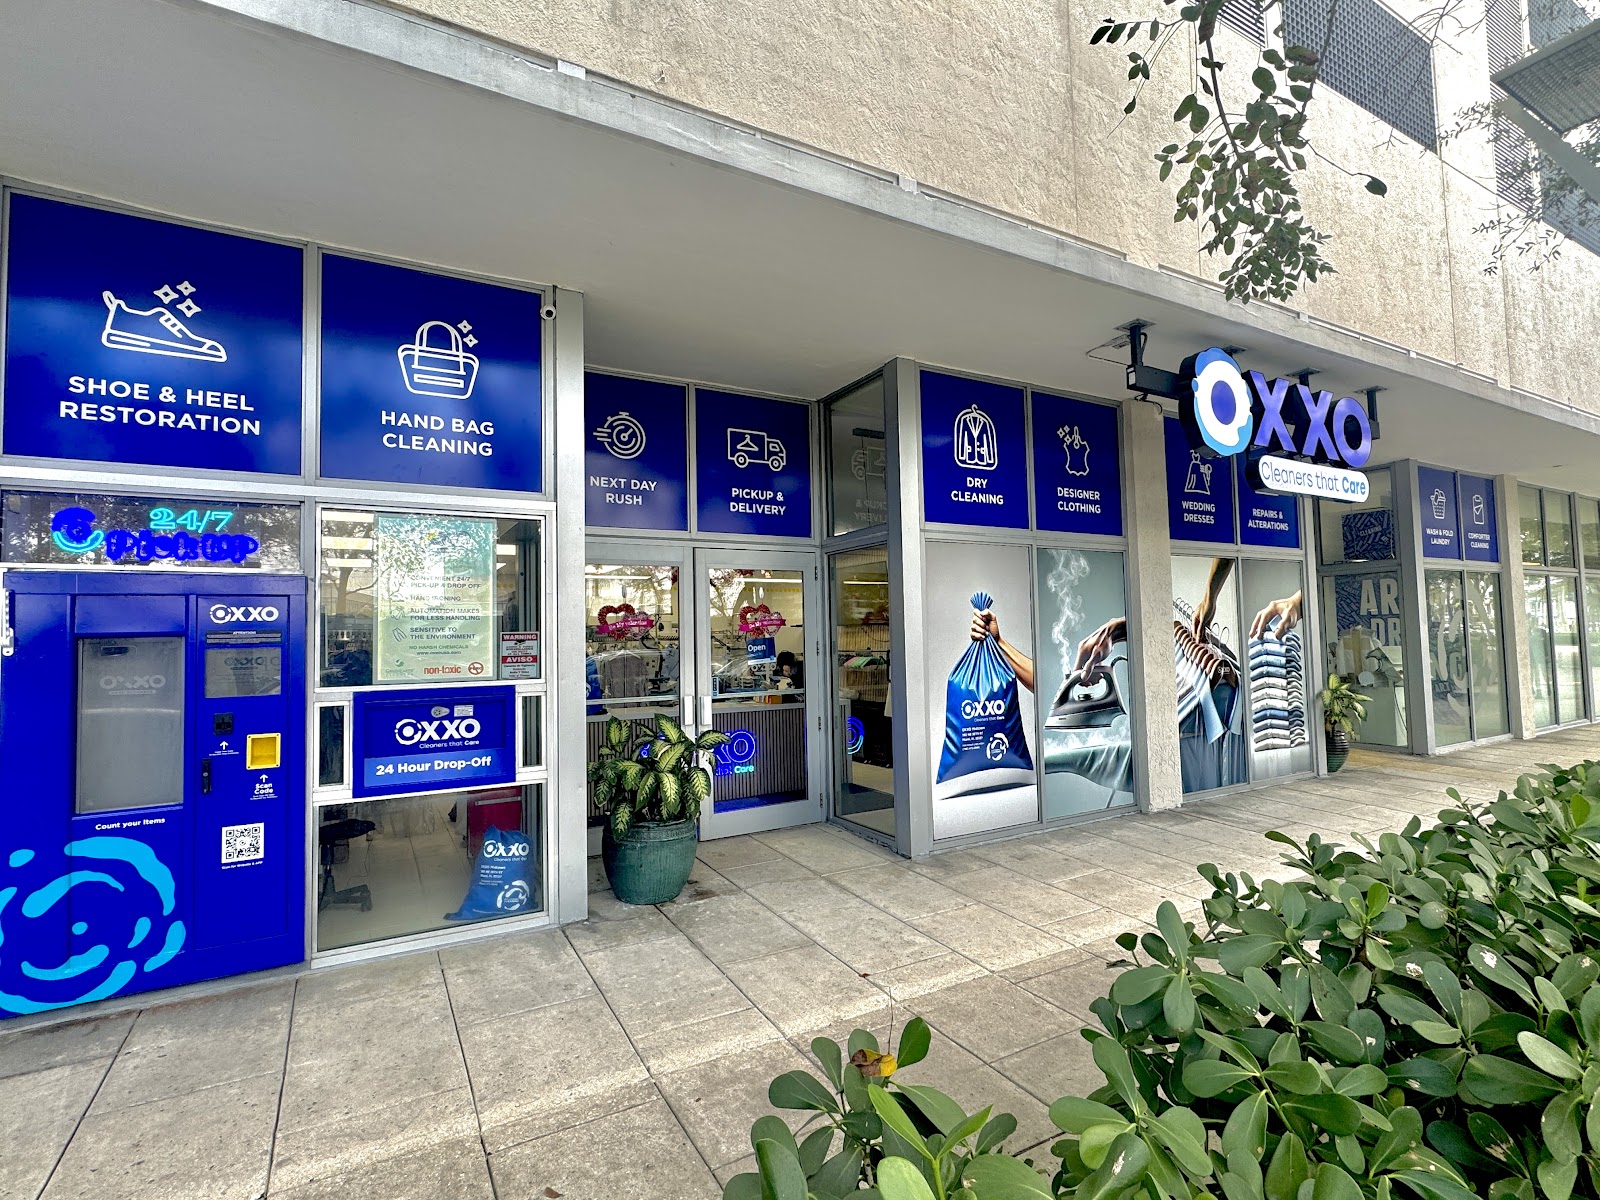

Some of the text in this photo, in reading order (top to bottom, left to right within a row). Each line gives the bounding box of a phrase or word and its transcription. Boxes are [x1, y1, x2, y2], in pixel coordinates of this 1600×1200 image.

[68, 376, 254, 411] SHOE & HEEL
[1192, 347, 1372, 468] OXXO
[59, 401, 261, 436] RESTORATION
[381, 410, 494, 436] HAND BAG
[382, 433, 493, 457] CLEANING
[589, 475, 658, 492] NEXT DAY
[966, 476, 988, 489] DRY
[1261, 461, 1366, 496] Cleaners that Care
[605, 492, 643, 506] RUSH
[731, 487, 784, 502] PICKUP &
[950, 490, 1004, 506] CLEANING
[1056, 487, 1101, 501] DESIGNER
[729, 502, 787, 516] DELIVERY
[1057, 500, 1101, 515] CLOTHING
[1181, 500, 1216, 512] WEDDING
[149, 507, 234, 533] 24/7
[1183, 513, 1215, 525] DRESSES
[1252, 508, 1283, 519] REPAIRS &
[1247, 519, 1289, 531] ALTERATIONS
[1442, 529, 1454, 537] FOLD
[1467, 532, 1490, 541] COMFORTER
[1430, 538, 1450, 546] LAUNDRY
[1470, 541, 1489, 549] CLEANING
[209, 604, 279, 624] OXXO
[747, 644, 766, 653] Open
[423, 665, 462, 675] non-toxic
[961, 699, 1005, 719] OXXO
[394, 718, 481, 746] OXXO
[375, 756, 492, 776] 24 Hour Drop-Off
[734, 765, 755, 774] Care
[95, 817, 166, 831] Count your Items
[483, 840, 530, 858] OXXO
